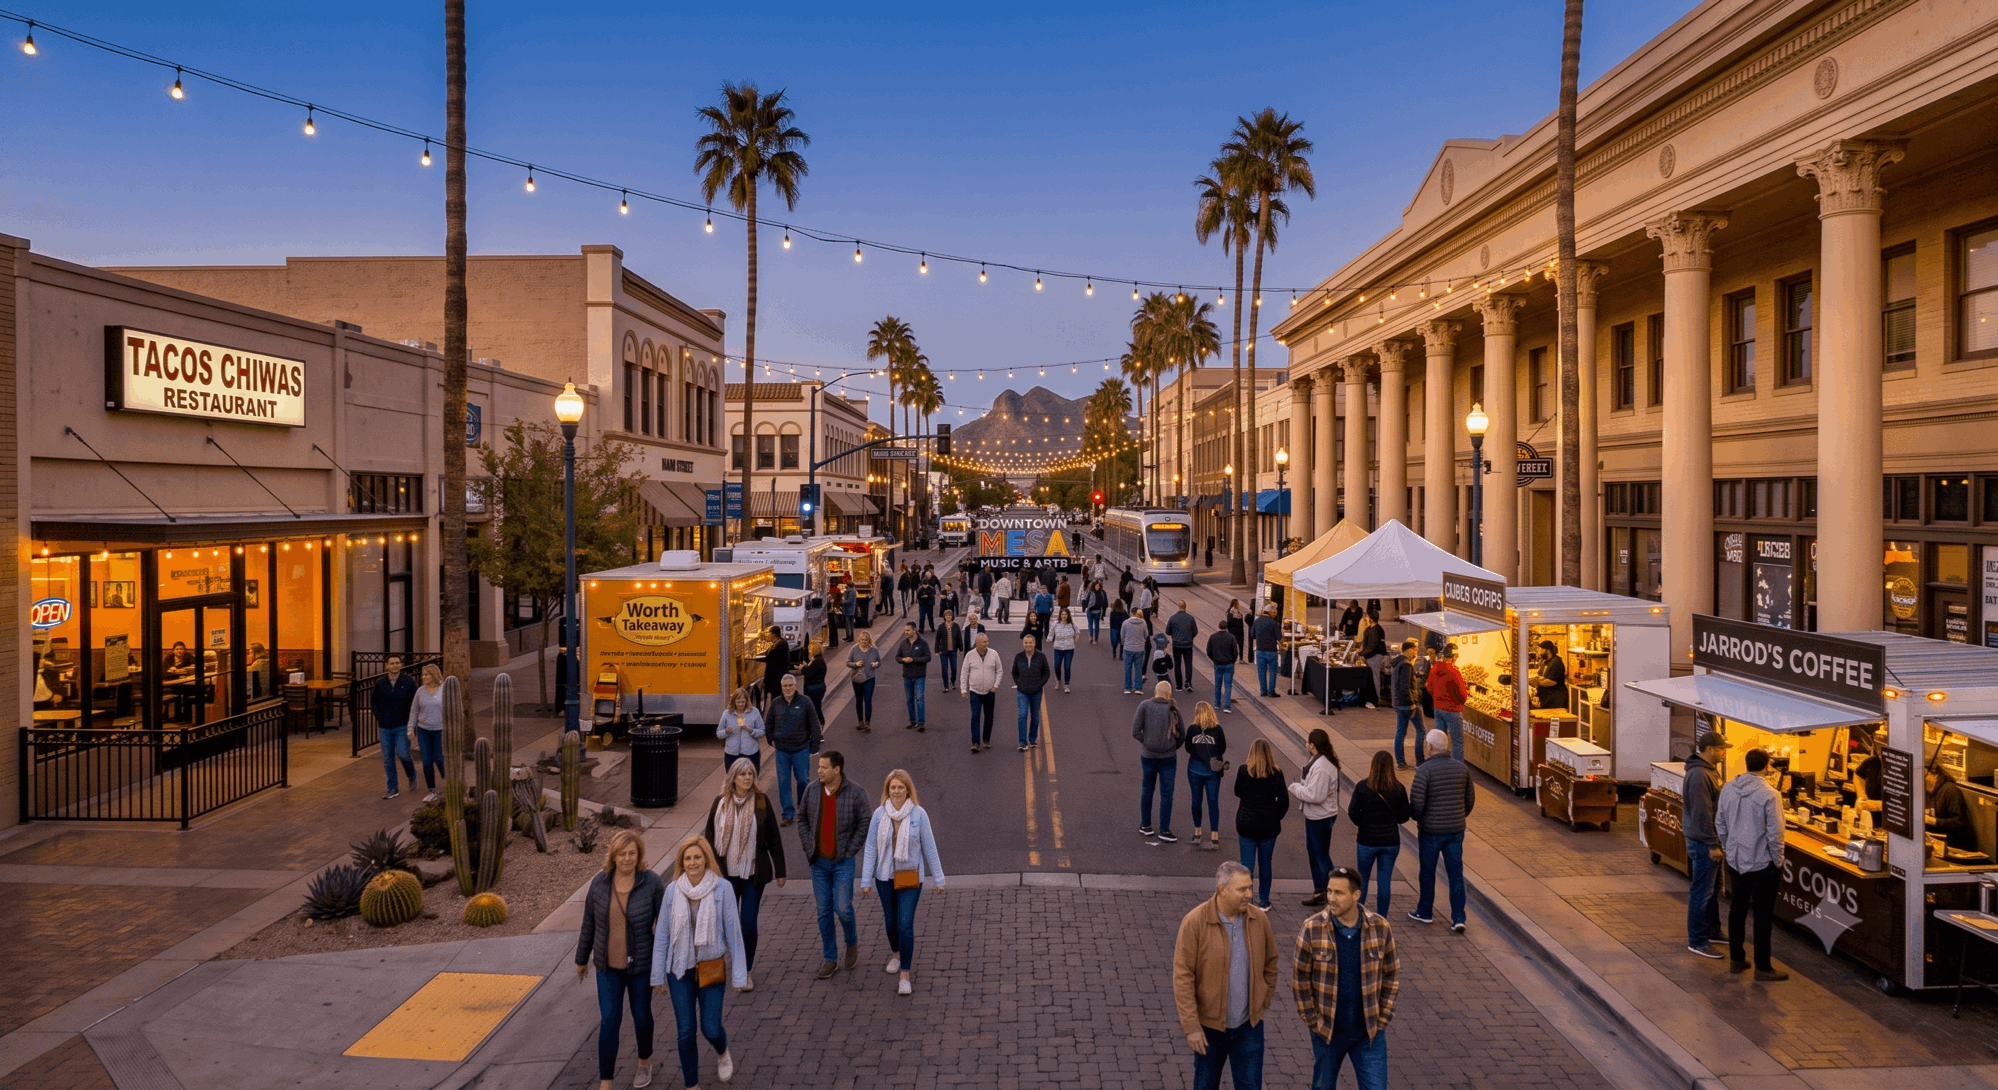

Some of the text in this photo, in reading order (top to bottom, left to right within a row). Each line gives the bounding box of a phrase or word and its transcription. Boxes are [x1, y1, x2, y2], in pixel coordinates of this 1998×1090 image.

[127, 336, 302, 397] TACOS CHIWAS
[164, 387, 278, 418] RESTAURANT
[980, 518, 1067, 529] DOWNTOWN
[979, 529, 1070, 557] MESA
[980, 558, 1020, 568] MUSIC
[1023, 558, 1031, 568] &
[31, 602, 70, 624] OPEN
[626, 602, 679, 618] Worth
[622, 618, 684, 634] Takeaway
[1699, 631, 1873, 690] JARROD'S COFFEE
[1798, 866, 1858, 914] COD'S
[1783, 891, 1822, 919] AEGEIS
